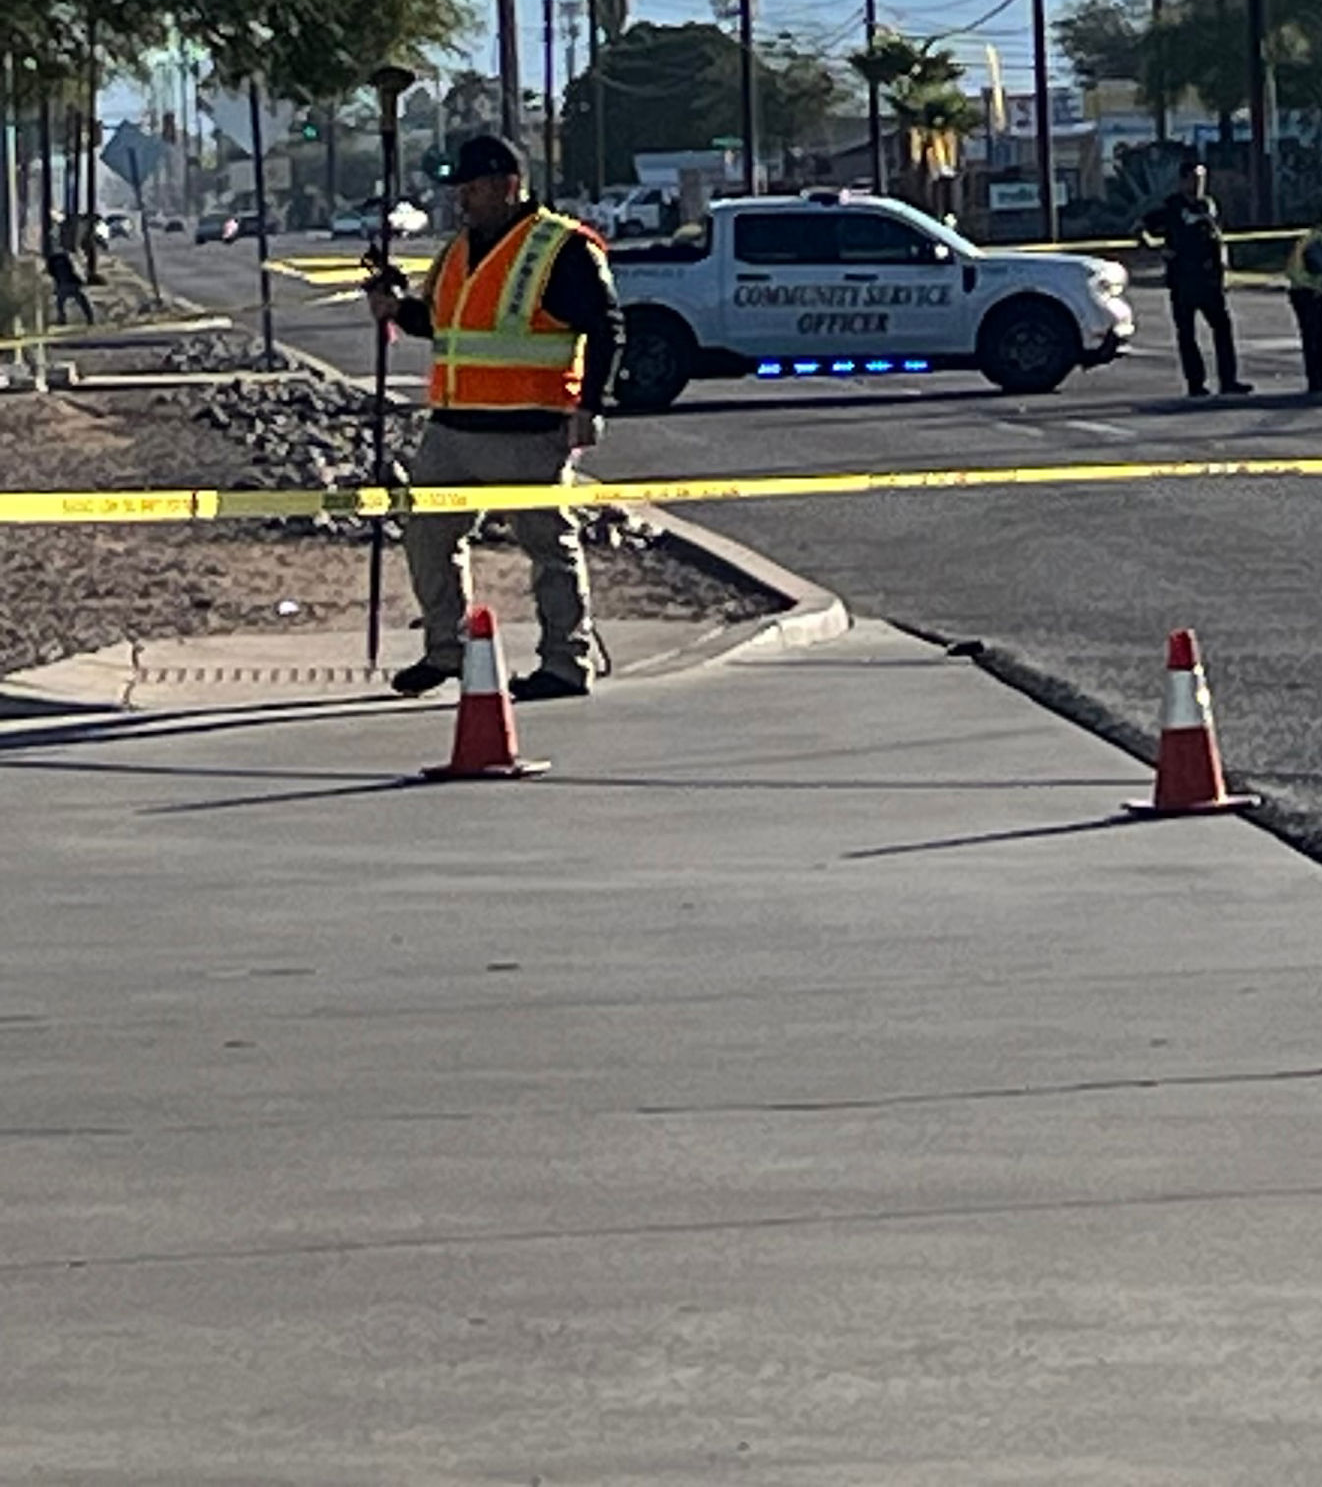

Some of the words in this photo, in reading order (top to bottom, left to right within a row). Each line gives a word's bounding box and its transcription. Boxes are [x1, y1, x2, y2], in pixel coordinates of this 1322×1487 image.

[734, 284, 859, 308] COMMUNITY
[863, 282, 953, 307] SERVICE
[797, 312, 890, 334] OFFICER
